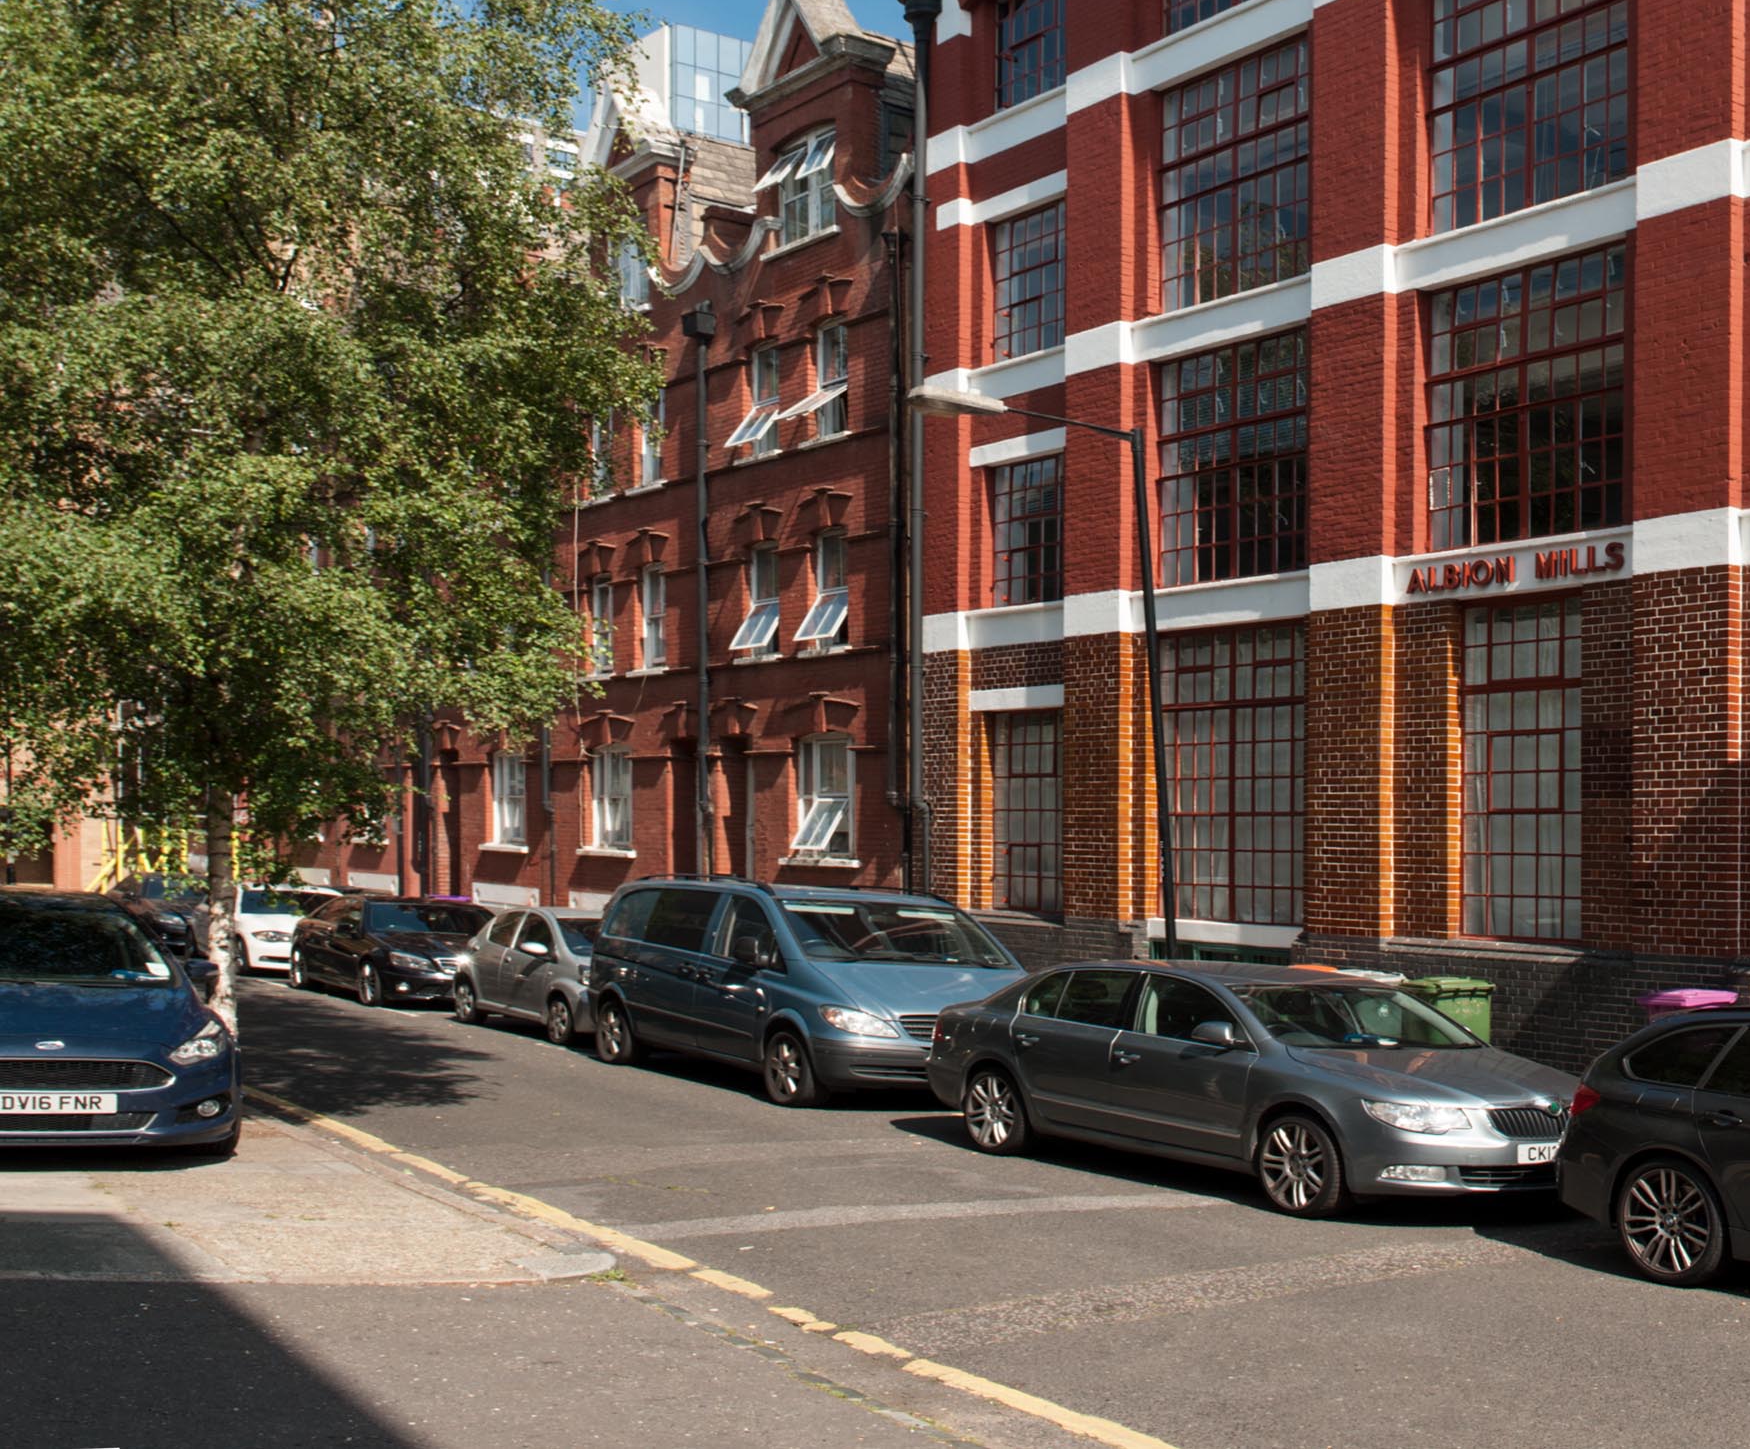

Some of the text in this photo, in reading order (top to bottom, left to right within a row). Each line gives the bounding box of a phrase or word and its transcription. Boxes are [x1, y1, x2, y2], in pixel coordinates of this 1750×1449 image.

[1406, 541, 1625, 594] ALBION MILLS
[1, 1095, 103, 1110] DV16 FNR
